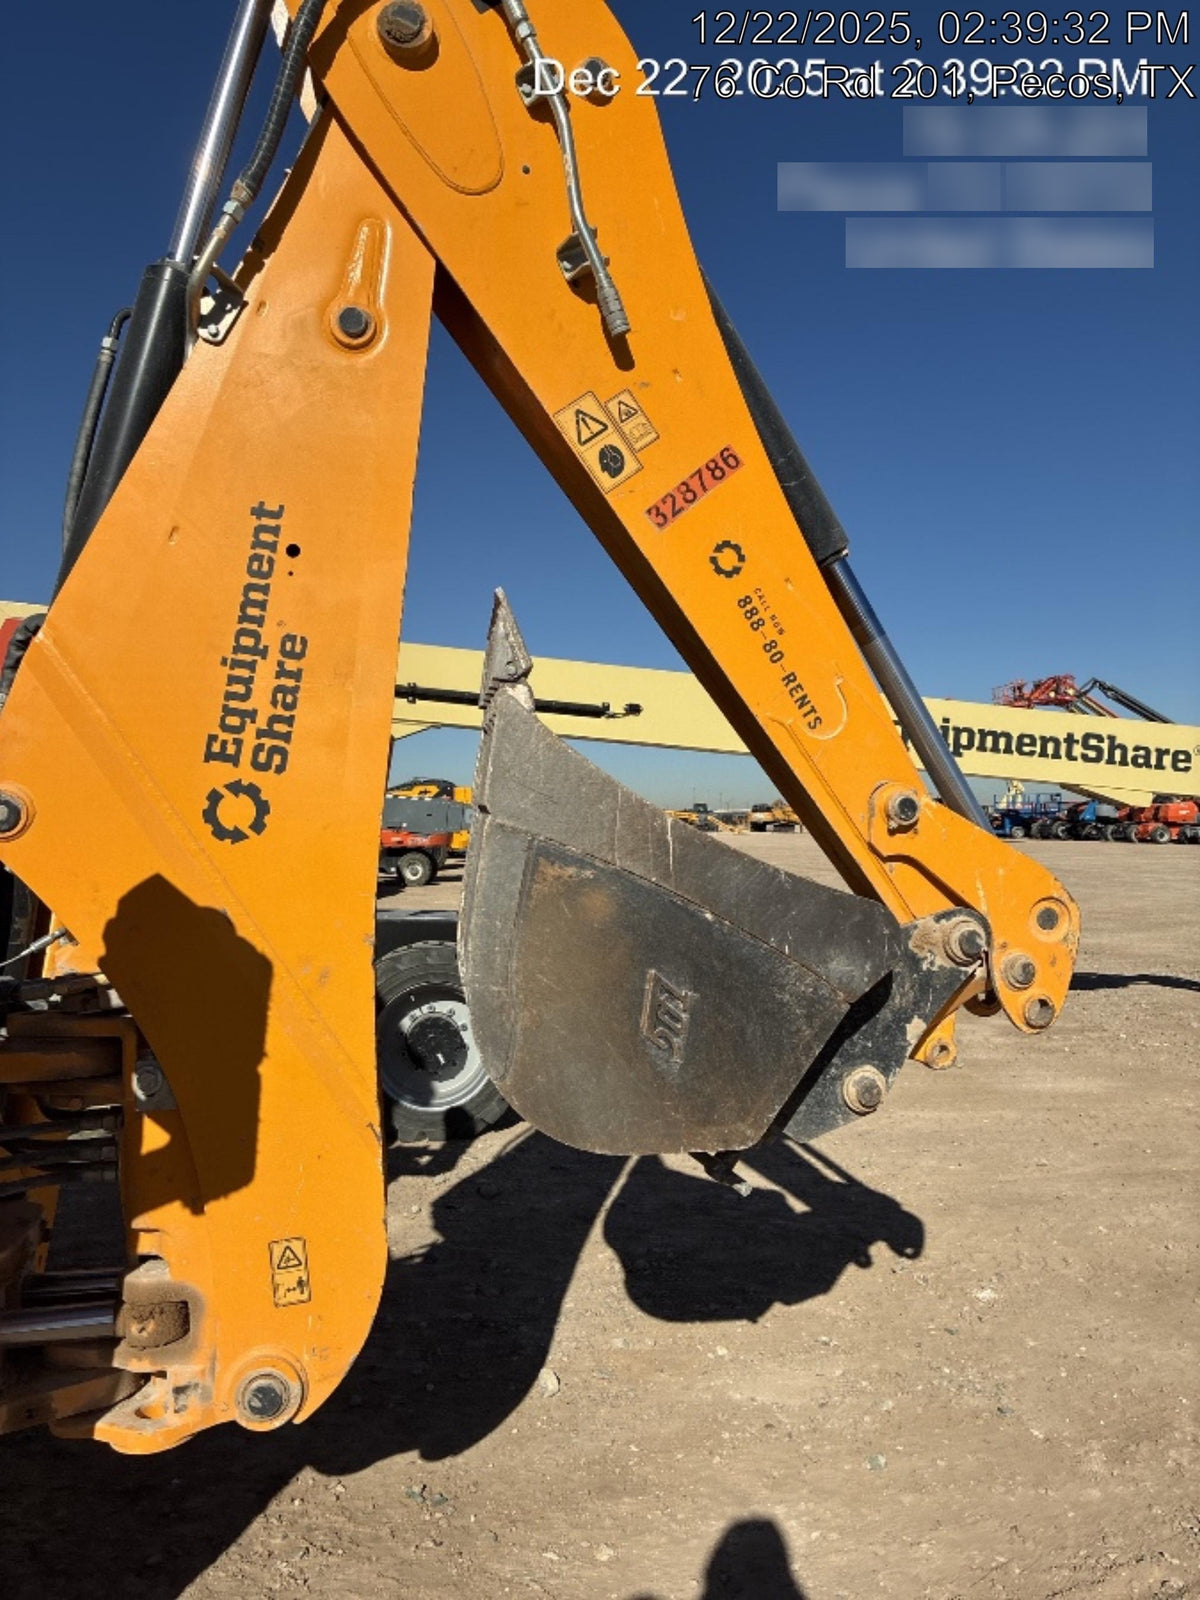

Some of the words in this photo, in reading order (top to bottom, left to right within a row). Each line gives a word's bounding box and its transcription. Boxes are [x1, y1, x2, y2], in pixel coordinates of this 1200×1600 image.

[645, 447, 741, 529] 328786
[203, 501, 285, 768] Equipment
[754, 588, 770, 611] CALL
[250, 632, 309, 775] Share
[737, 595, 822, 730] 888-80-RENTS
[893, 717, 1193, 773] ipmentShare
